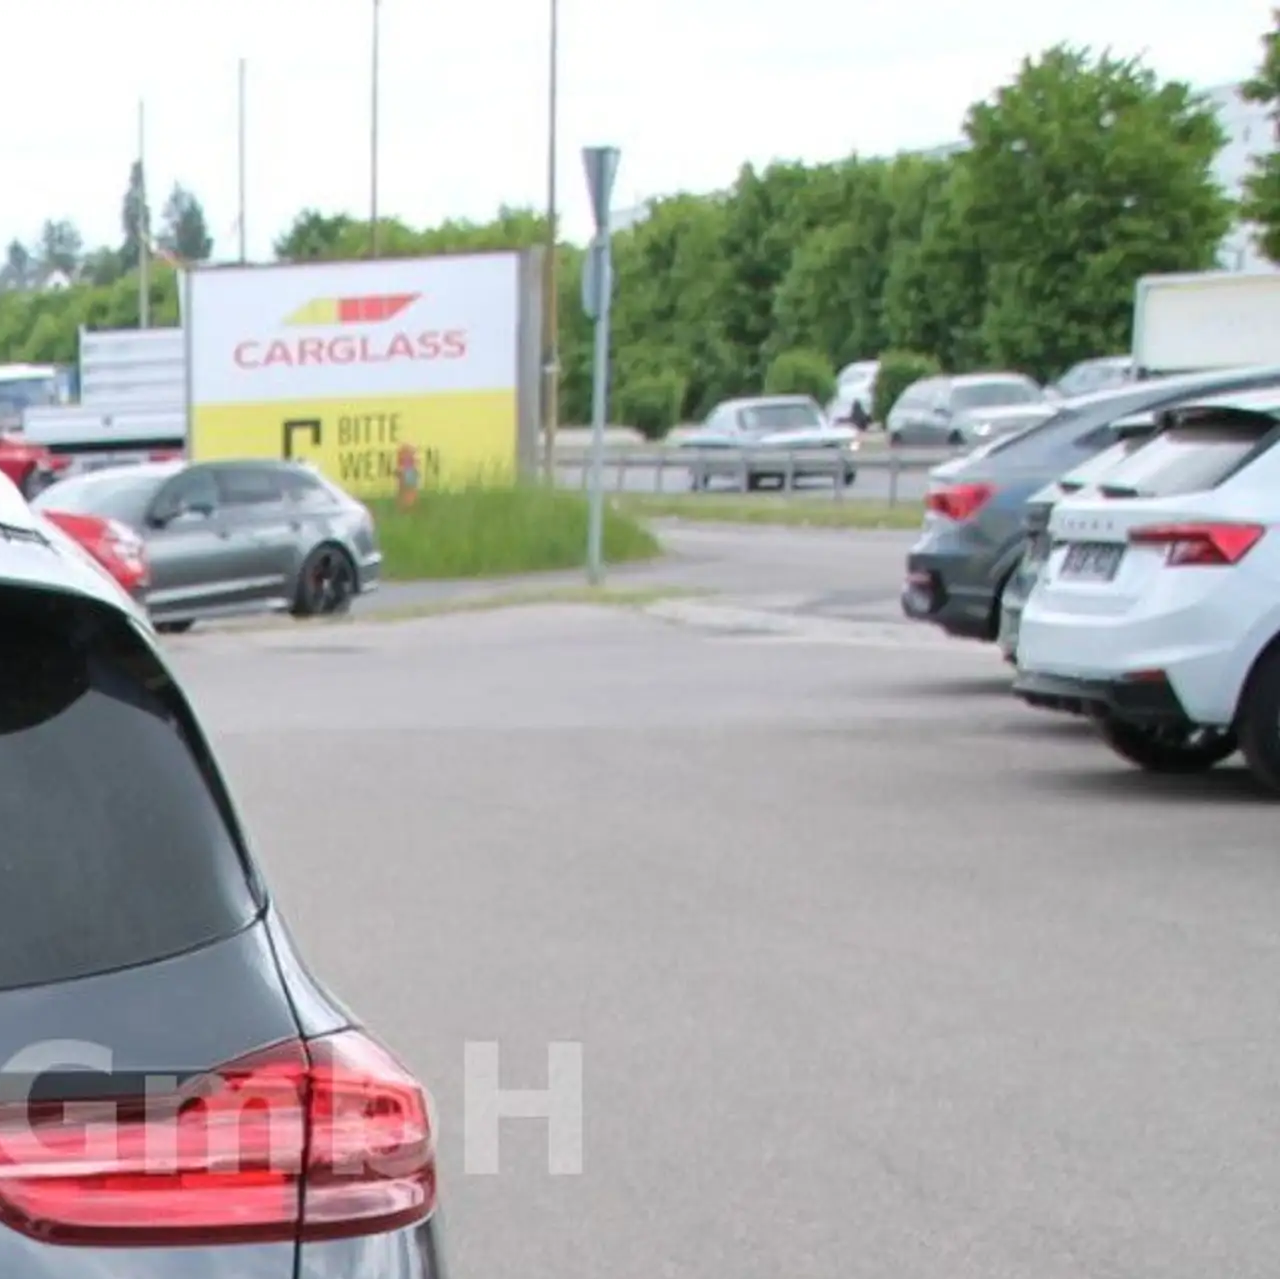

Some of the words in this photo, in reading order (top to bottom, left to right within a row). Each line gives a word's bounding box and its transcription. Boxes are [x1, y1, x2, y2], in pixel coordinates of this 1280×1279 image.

[233, 330, 467, 370] CARGLASS
[338, 412, 402, 446] BITTE
[338, 447, 440, 481] WENN
